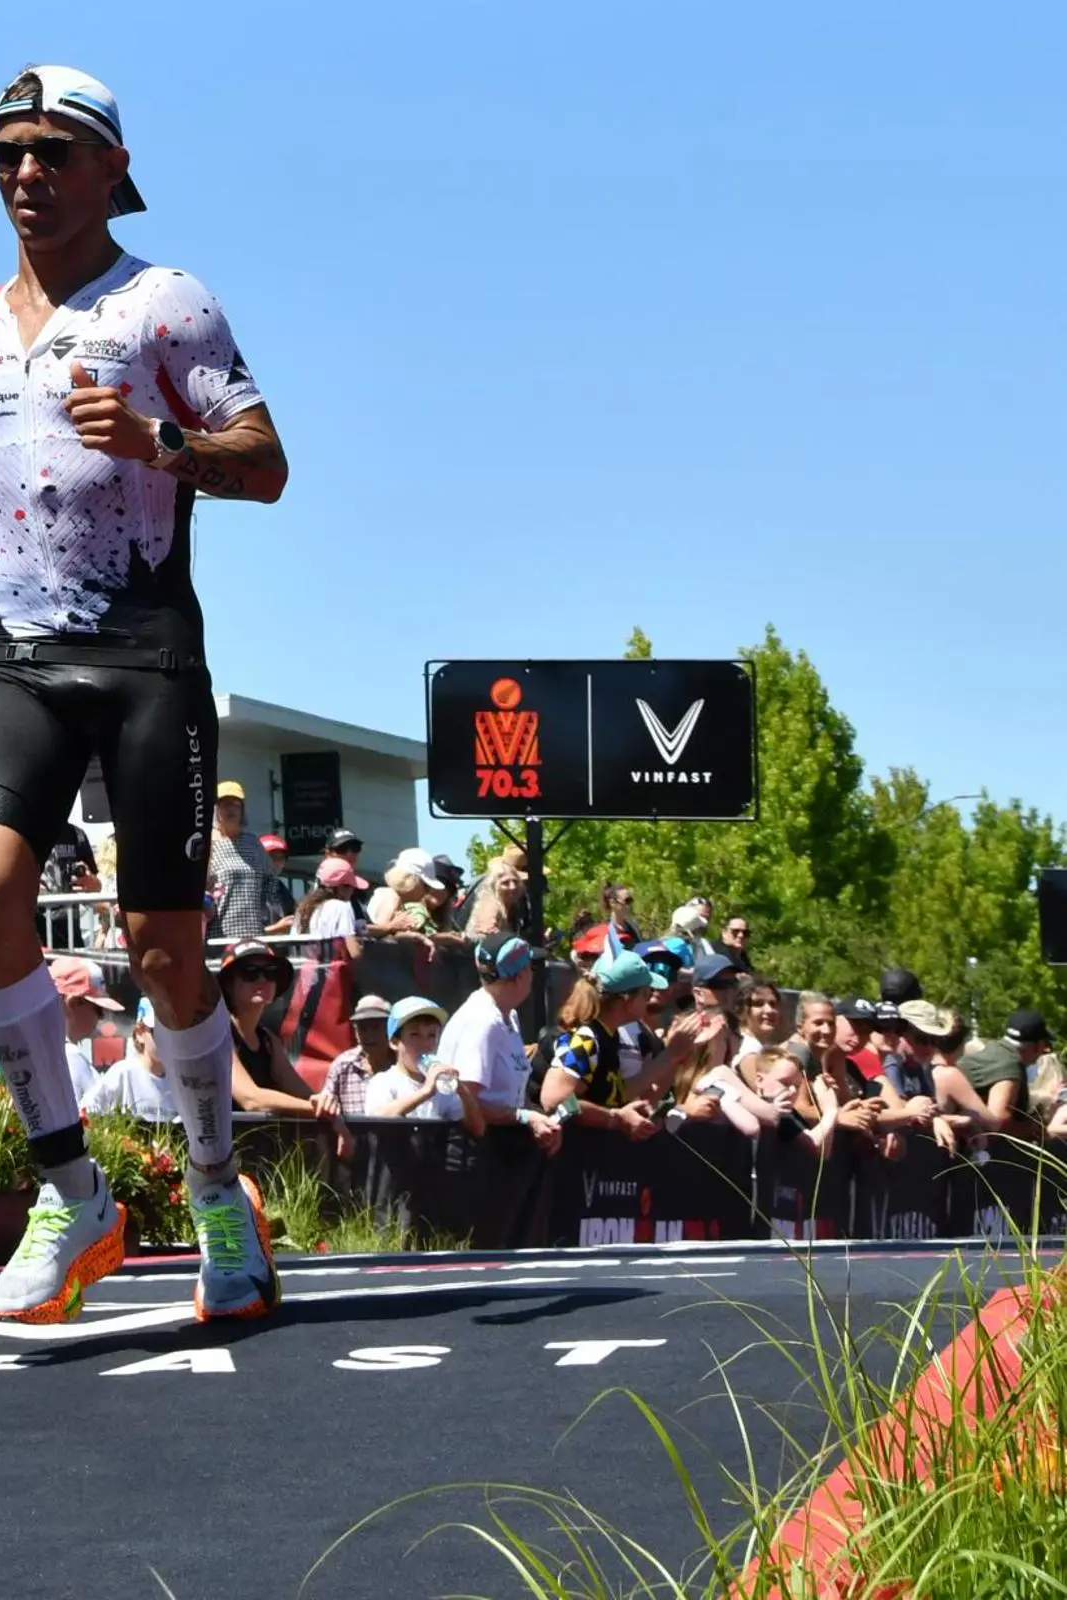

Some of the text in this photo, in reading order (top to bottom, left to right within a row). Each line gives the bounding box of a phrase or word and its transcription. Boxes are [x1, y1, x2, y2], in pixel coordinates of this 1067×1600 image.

[185, 724, 205, 829] mobitec
[476, 769, 540, 798] 70.3
[631, 771, 713, 784] VINFAST
